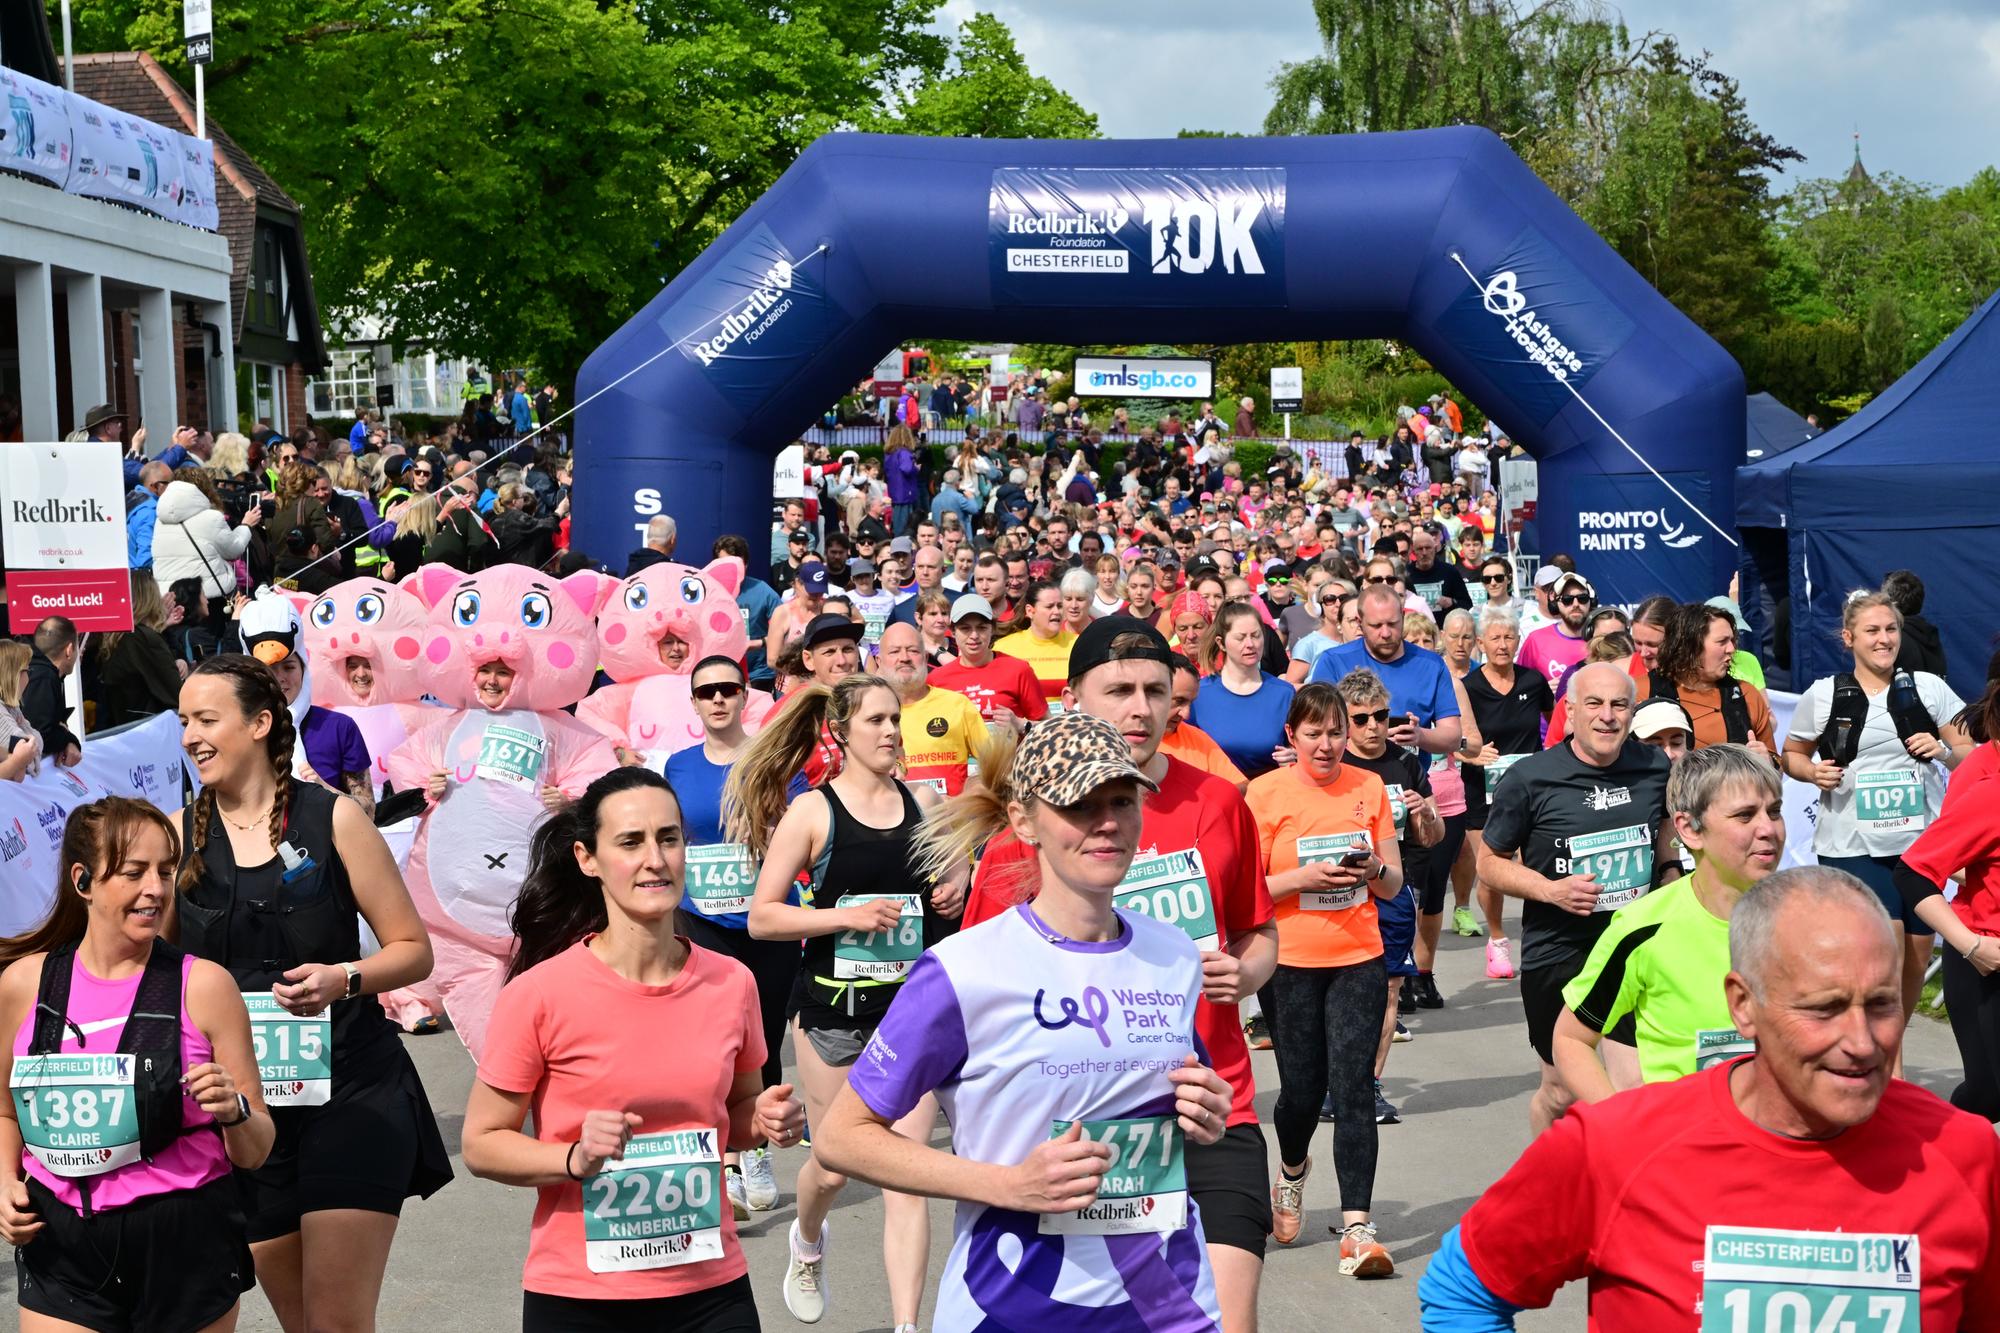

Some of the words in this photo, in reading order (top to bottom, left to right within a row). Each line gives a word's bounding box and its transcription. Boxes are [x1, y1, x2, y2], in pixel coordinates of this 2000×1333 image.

[1007, 211, 1106, 235] Redbrik.
[1050, 236, 1106, 248] Foundation
[1143, 199, 1266, 275] 10K
[1012, 253, 1124, 268] CHESTERFIELD
[694, 289, 783, 367] Redbrik.
[744, 297, 793, 345] Foundation
[1505, 318, 1568, 382] Hospice
[1519, 310, 1582, 373] Ashgate
[12, 498, 113, 524] Redbrik.
[1578, 511, 1659, 529] PRONTO
[38, 548, 84, 557] redbrik.co.uk
[1579, 533, 1646, 551] PAINTS
[31, 595, 67, 608] Good
[67, 592, 104, 607] Luck!
[486, 739, 536, 769] 1671
[1861, 786, 1916, 810] 1091
[1878, 809, 1903, 819] PAIGE
[1579, 848, 1644, 880] 1971
[691, 864, 756, 887] 1465
[705, 888, 742, 898] ABIGAIL
[1112, 883, 1206, 925] 200
[1112, 988, 1186, 1008] Weston
[1122, 1009, 1171, 1029] Park
[1127, 1033, 1163, 1044] Cancer
[17, 1062, 91, 1073] CHESTERFIELD
[94, 1056, 129, 1076] 10K
[1038, 1058, 1112, 1079] Together
[1115, 1058, 1127, 1072] at
[1130, 1061, 1169, 1074] every
[1170, 1059, 1188, 1069] ste
[22, 1088, 125, 1128] 1387
[49, 1132, 102, 1146] CLAIRE
[674, 1131, 712, 1156] 10K
[47, 1153, 100, 1166] Redbrik.
[591, 1167, 712, 1219] 2260
[1097, 1175, 1145, 1194] ARAH
[1076, 1201, 1142, 1220] Redbrik.
[609, 1213, 698, 1238] KIMBERLEY
[620, 1239, 682, 1259] Redbrik.
[1717, 1240, 1854, 1264] CHESTERFIELD
[1860, 1238, 1912, 1273] 10K
[1724, 1288, 1907, 1333] 1047
